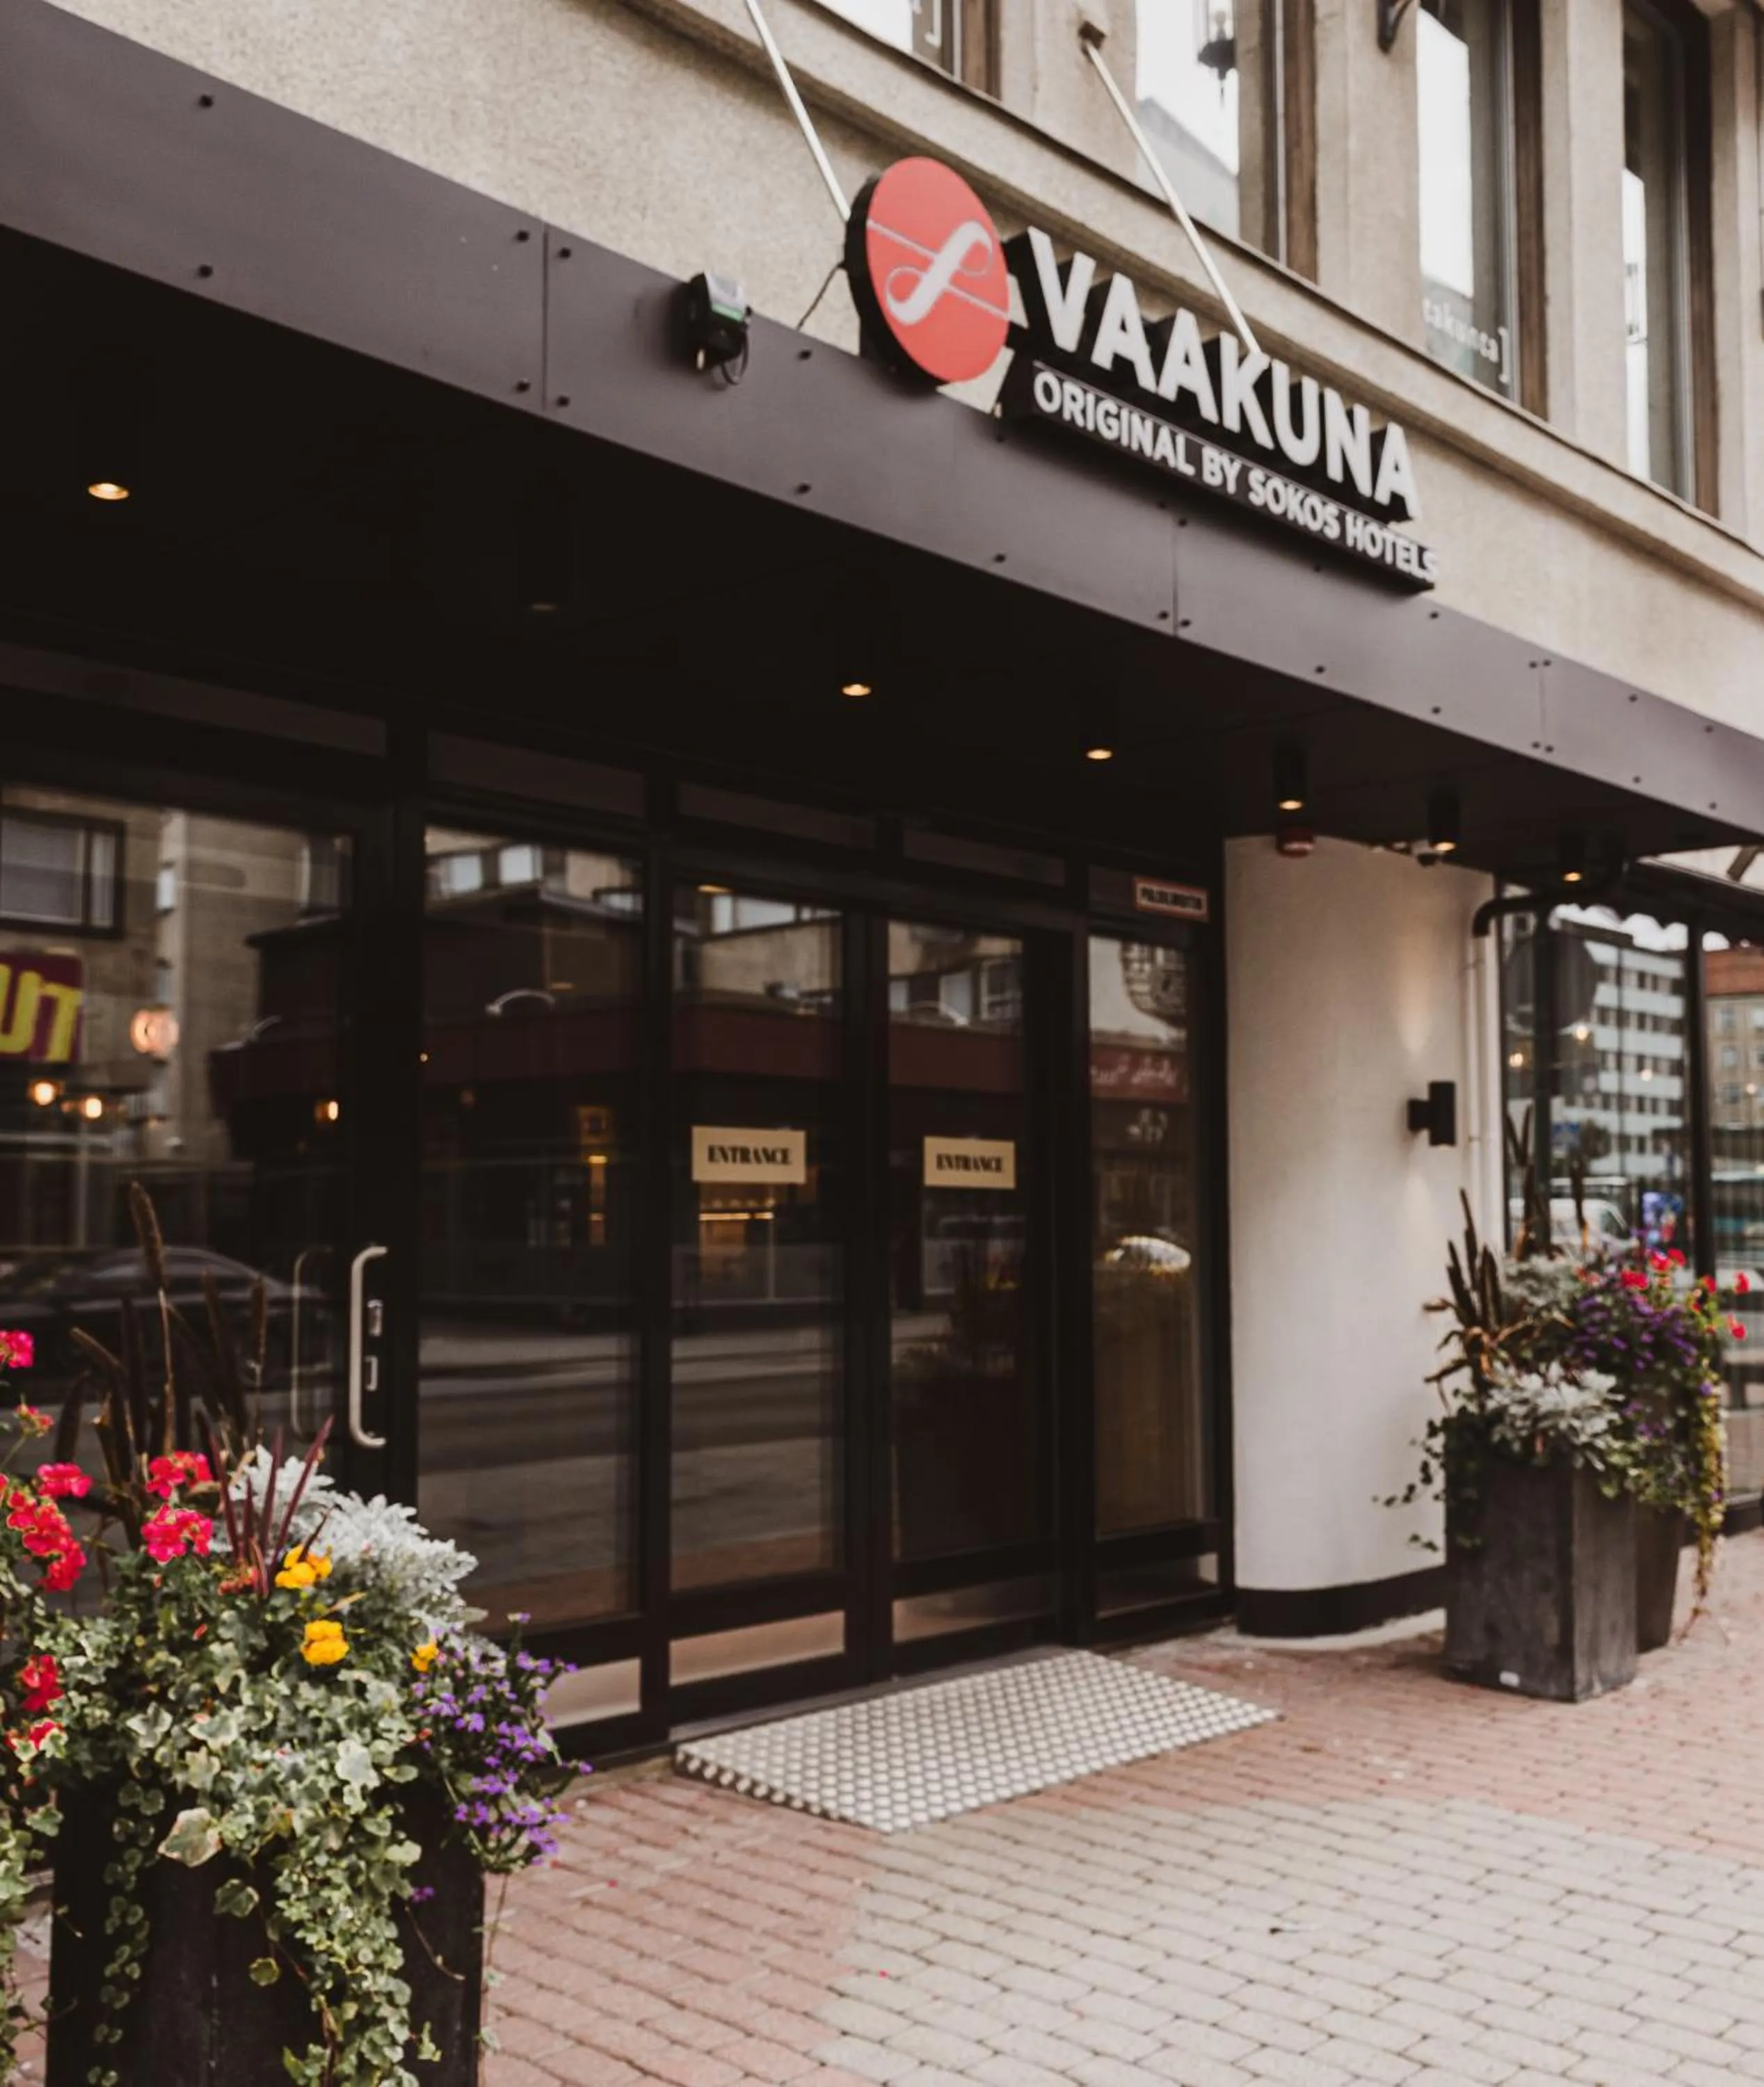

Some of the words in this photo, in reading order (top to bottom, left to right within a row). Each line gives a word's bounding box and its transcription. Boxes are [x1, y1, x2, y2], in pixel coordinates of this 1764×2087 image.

[1027, 225, 1423, 520] VAAKUNA
[1034, 371, 1195, 477] ORIGINAL
[1203, 451, 1241, 494] BY
[1249, 469, 1340, 542] SOKOS
[1346, 513, 1439, 584] HOTELS
[707, 1144, 792, 1166] ENTRANCE
[936, 1153, 1003, 1173] ENTRANCE
